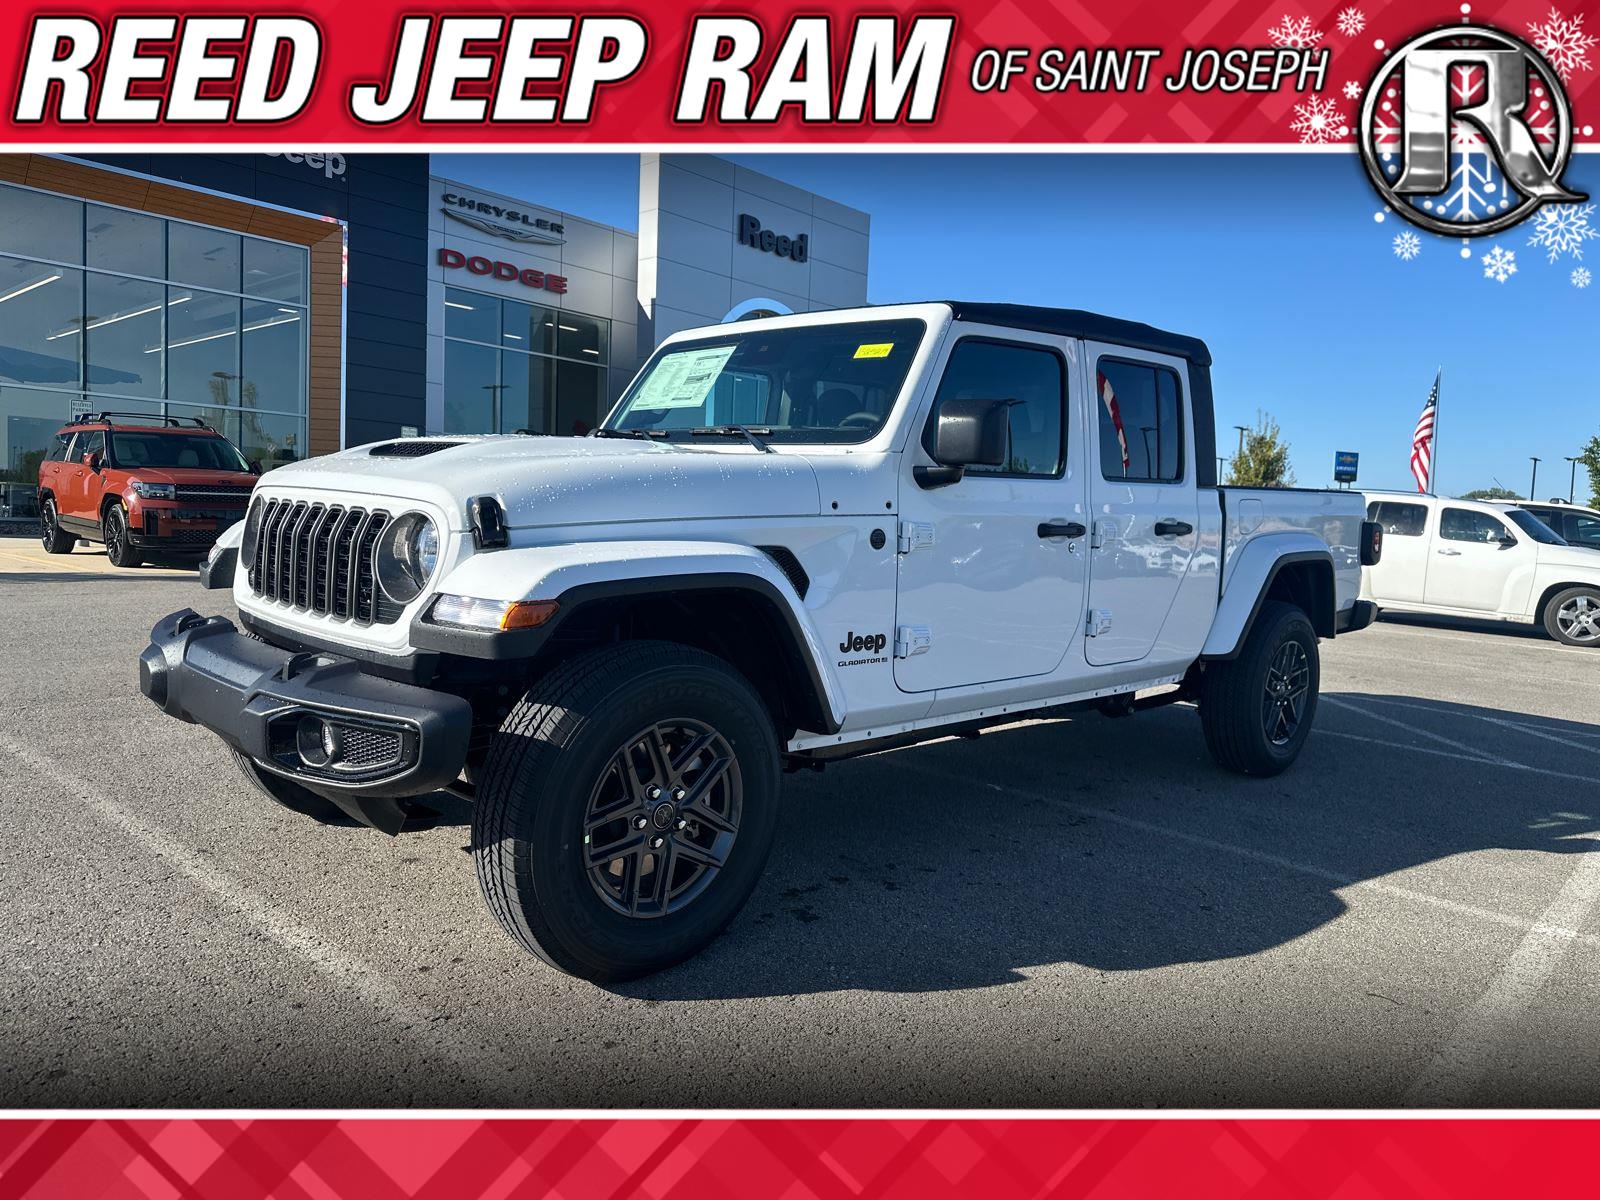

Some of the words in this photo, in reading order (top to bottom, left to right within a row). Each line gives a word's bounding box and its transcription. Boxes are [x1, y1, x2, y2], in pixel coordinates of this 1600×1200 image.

[442, 193, 565, 235] CHRYSLER
[738, 213, 808, 263] Reed
[438, 247, 567, 294] DODGE
[837, 657, 881, 668] GLADIATOR
[839, 631, 887, 654] Jeep
